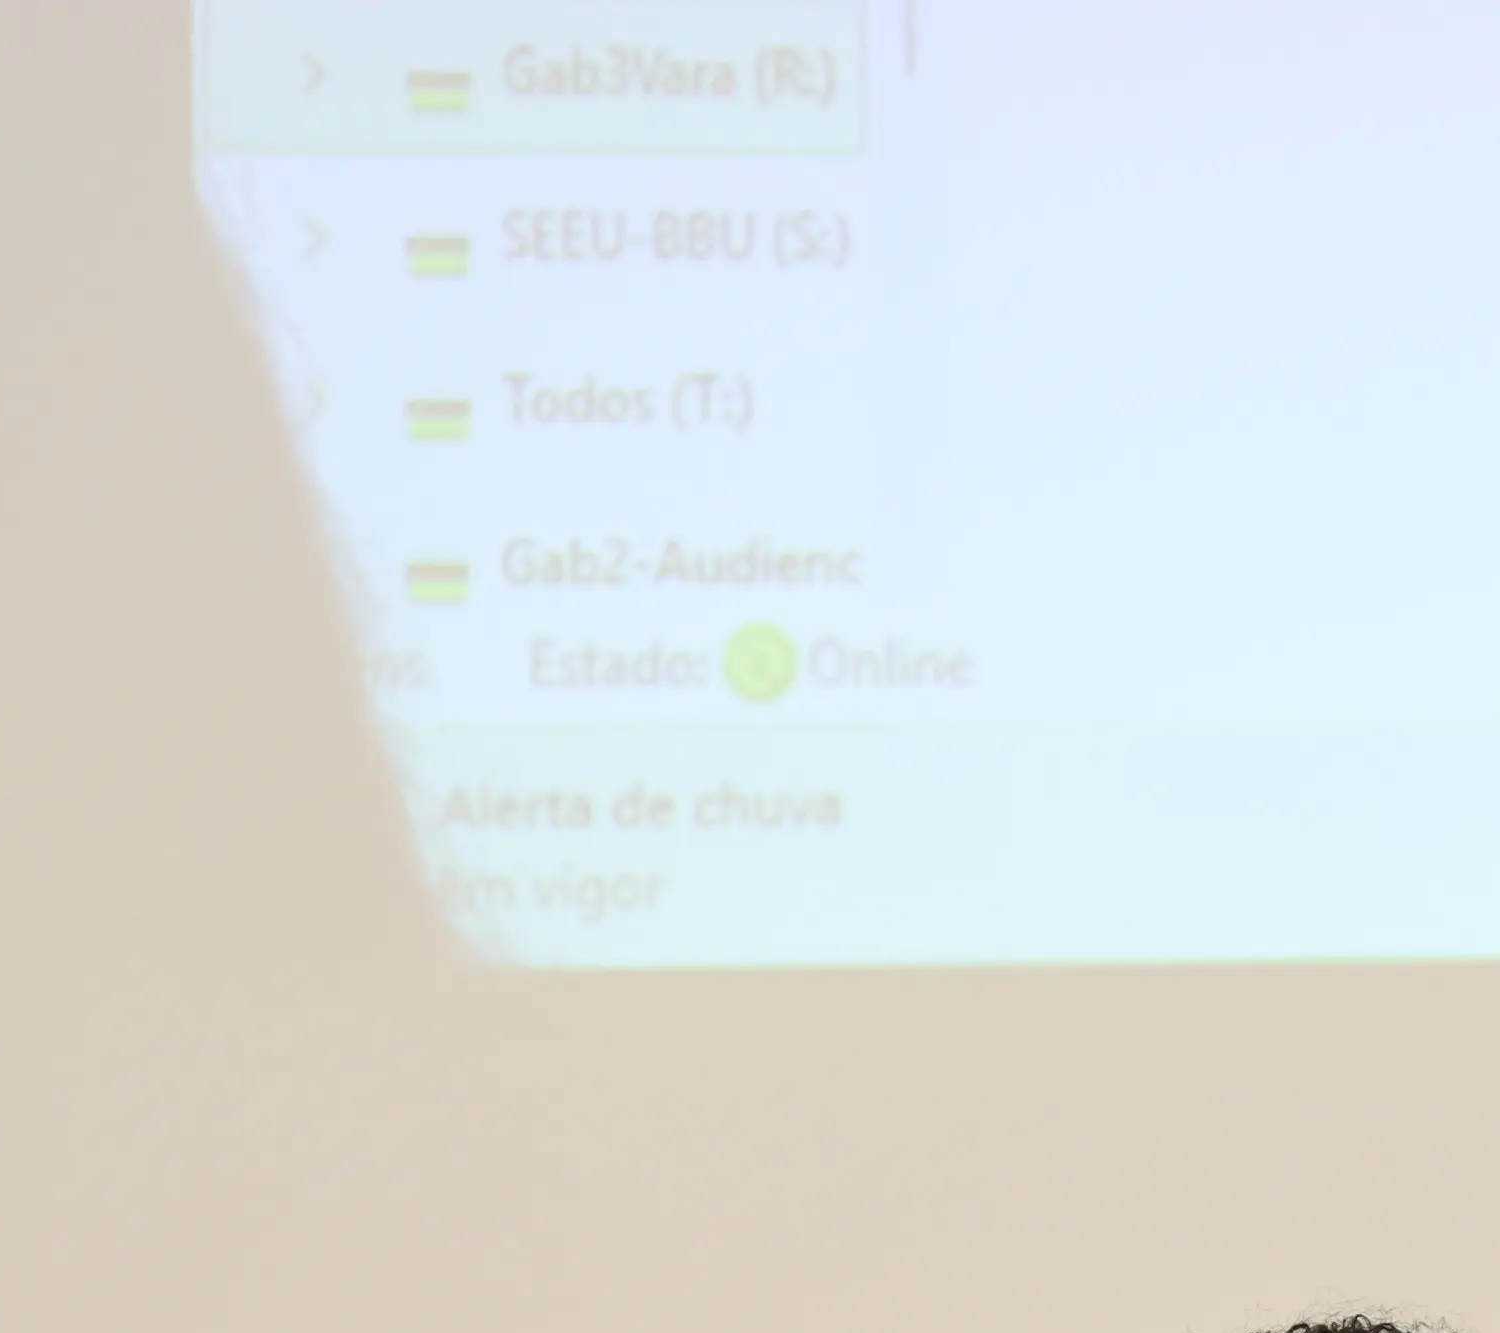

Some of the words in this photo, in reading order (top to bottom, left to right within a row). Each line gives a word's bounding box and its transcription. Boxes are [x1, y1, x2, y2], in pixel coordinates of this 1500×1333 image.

[500, 42, 740, 98] Gab3Vara
[500, 210, 755, 264] SEEU-BBU
[773, 211, 853, 269] (S:)
[502, 372, 656, 425] Todos
[671, 373, 756, 430] (T:)
[501, 537, 864, 588] Gab2-Audienc
[808, 635, 975, 690] Online
[441, 782, 593, 829] Alerta
[612, 786, 676, 829] de
[693, 782, 845, 828] chuva
[533, 863, 666, 924] vigor
